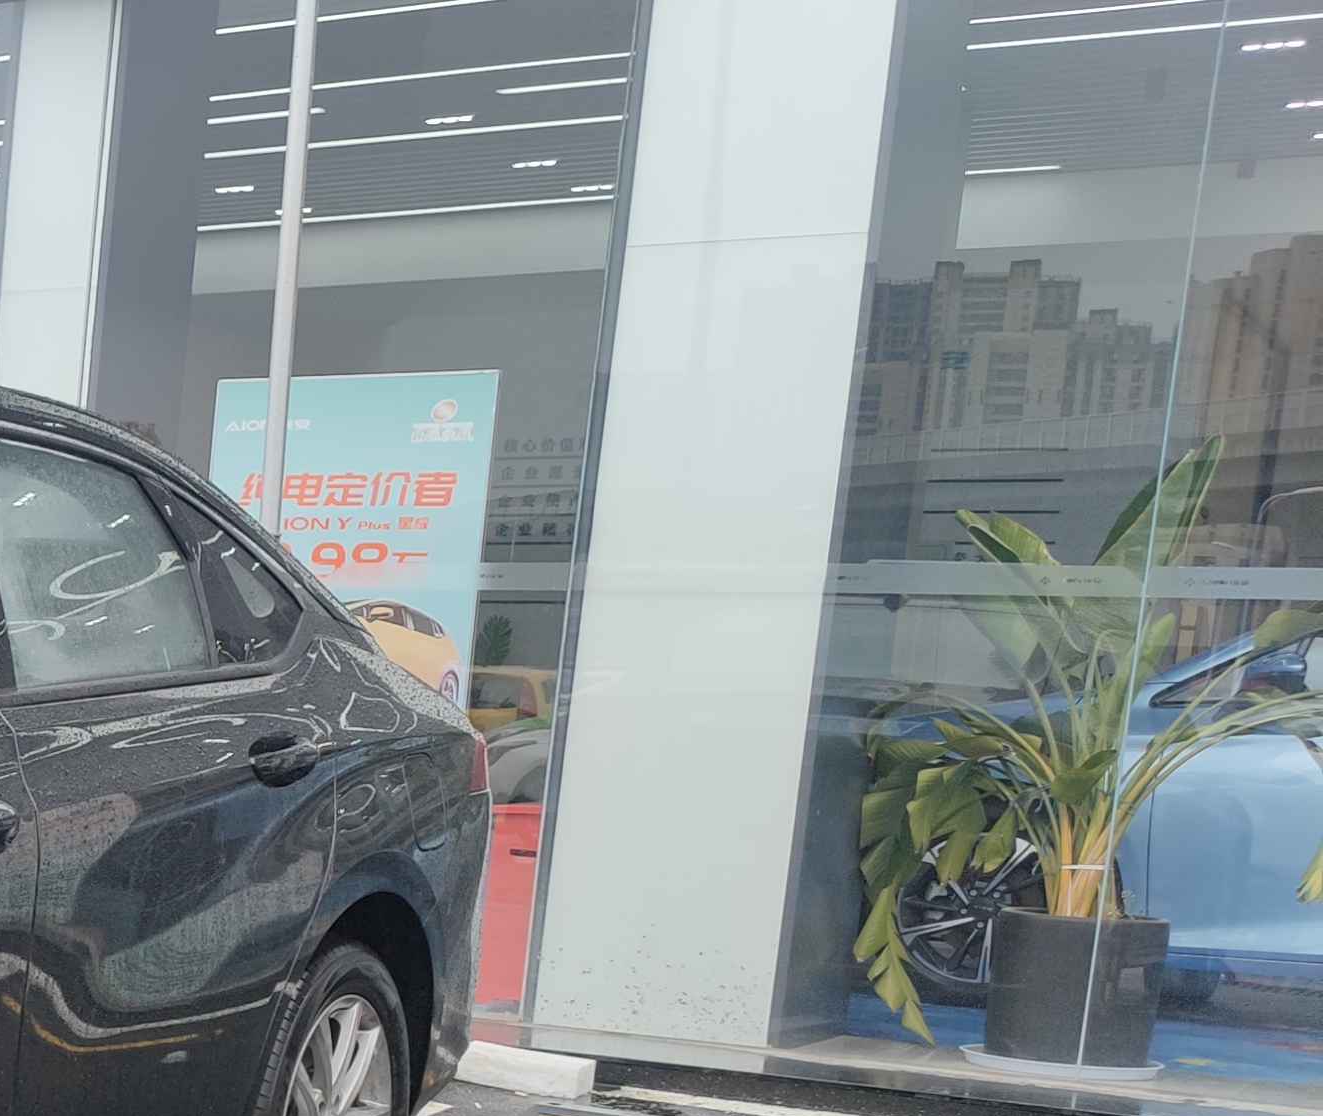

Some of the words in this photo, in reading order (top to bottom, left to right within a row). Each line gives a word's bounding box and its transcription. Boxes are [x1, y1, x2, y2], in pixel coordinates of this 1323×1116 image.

[283, 517, 330, 530] ION
[337, 517, 353, 530] Y
[357, 520, 391, 530] Plus
